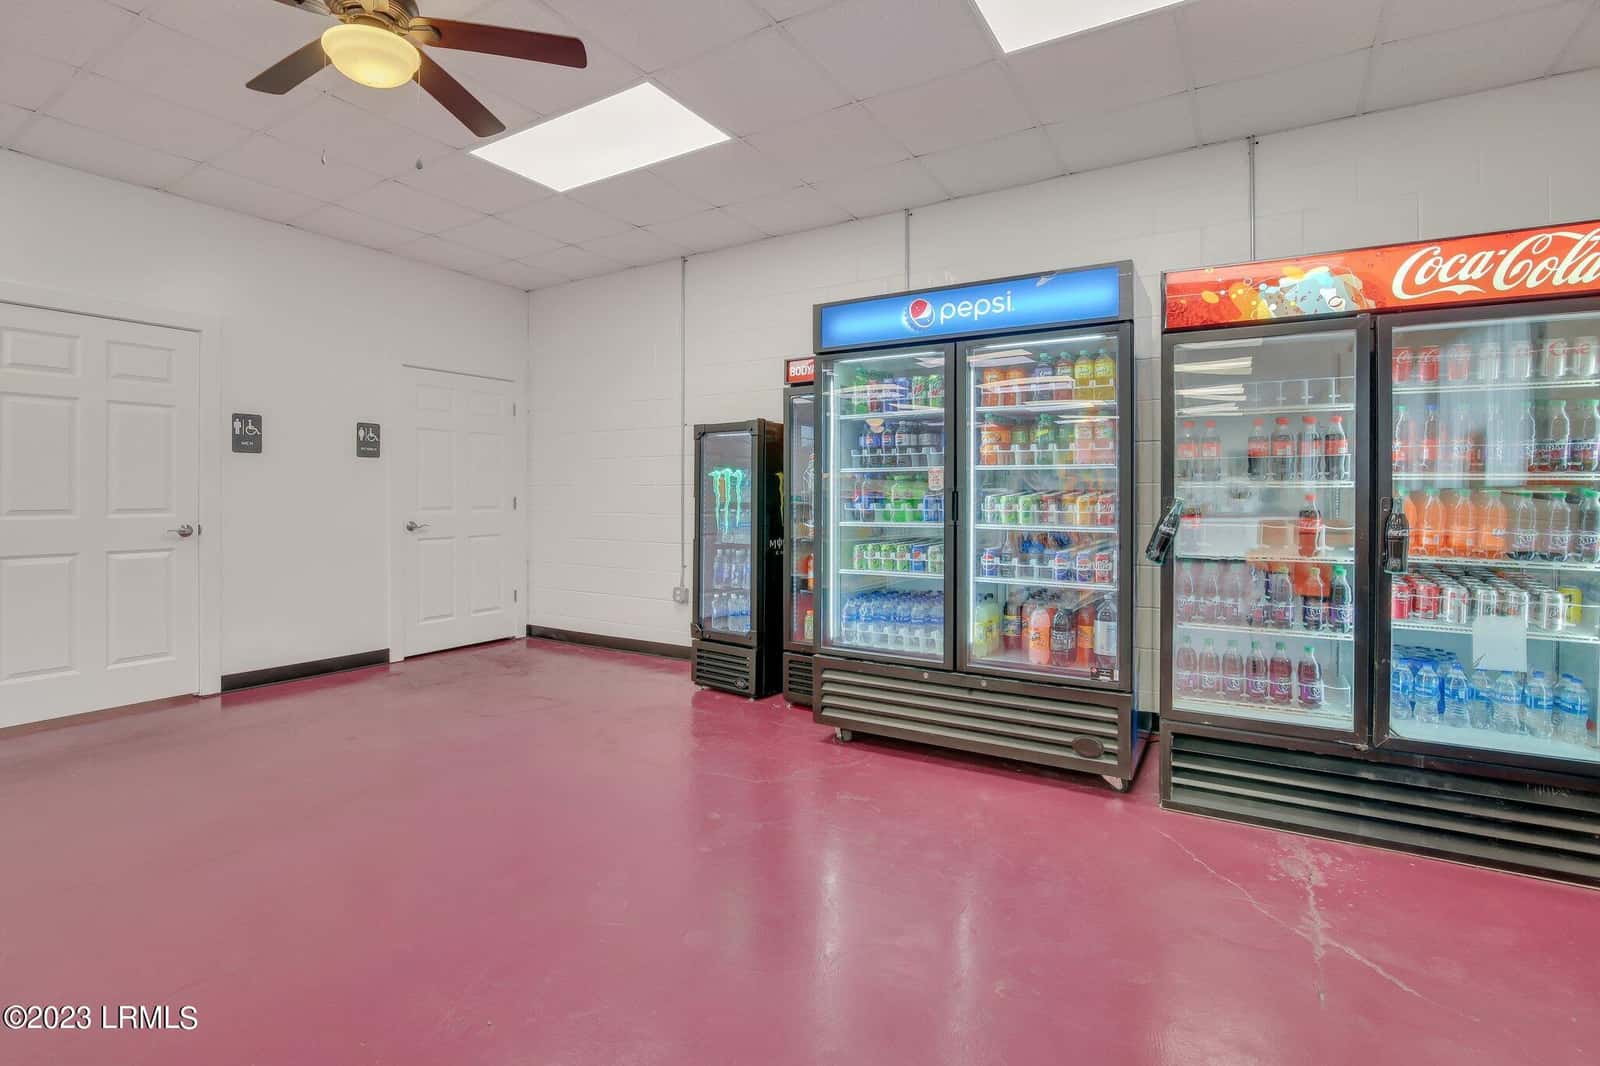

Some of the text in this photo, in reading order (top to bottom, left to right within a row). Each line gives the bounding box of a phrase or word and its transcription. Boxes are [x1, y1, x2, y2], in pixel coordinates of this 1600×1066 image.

[1391, 228, 1600, 300] Coca-Cola
[940, 290, 1012, 325] pepsi
[789, 364, 815, 377] BODY
